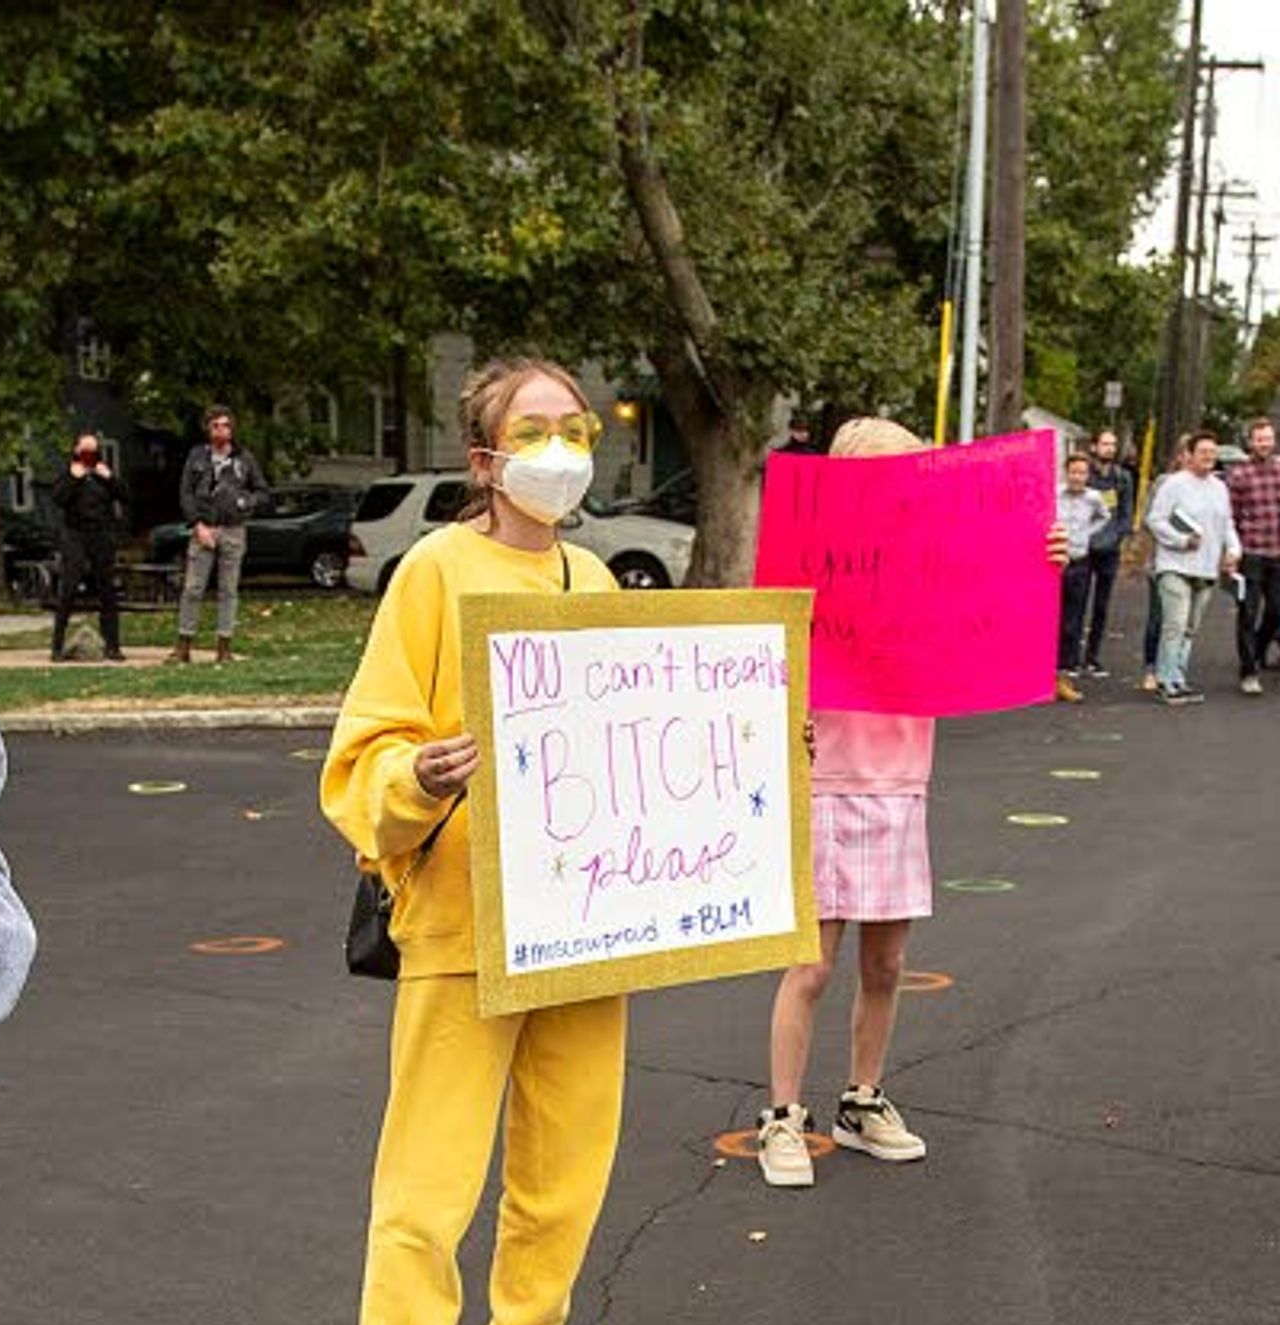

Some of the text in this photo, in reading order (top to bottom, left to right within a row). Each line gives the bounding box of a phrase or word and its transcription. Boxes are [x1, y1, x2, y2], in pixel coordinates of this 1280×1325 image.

[493, 637, 562, 707] YOU
[585, 643, 685, 702] can't
[539, 713, 742, 843] BITCH
[579, 825, 757, 924] please
[679, 896, 753, 937] #BLM
